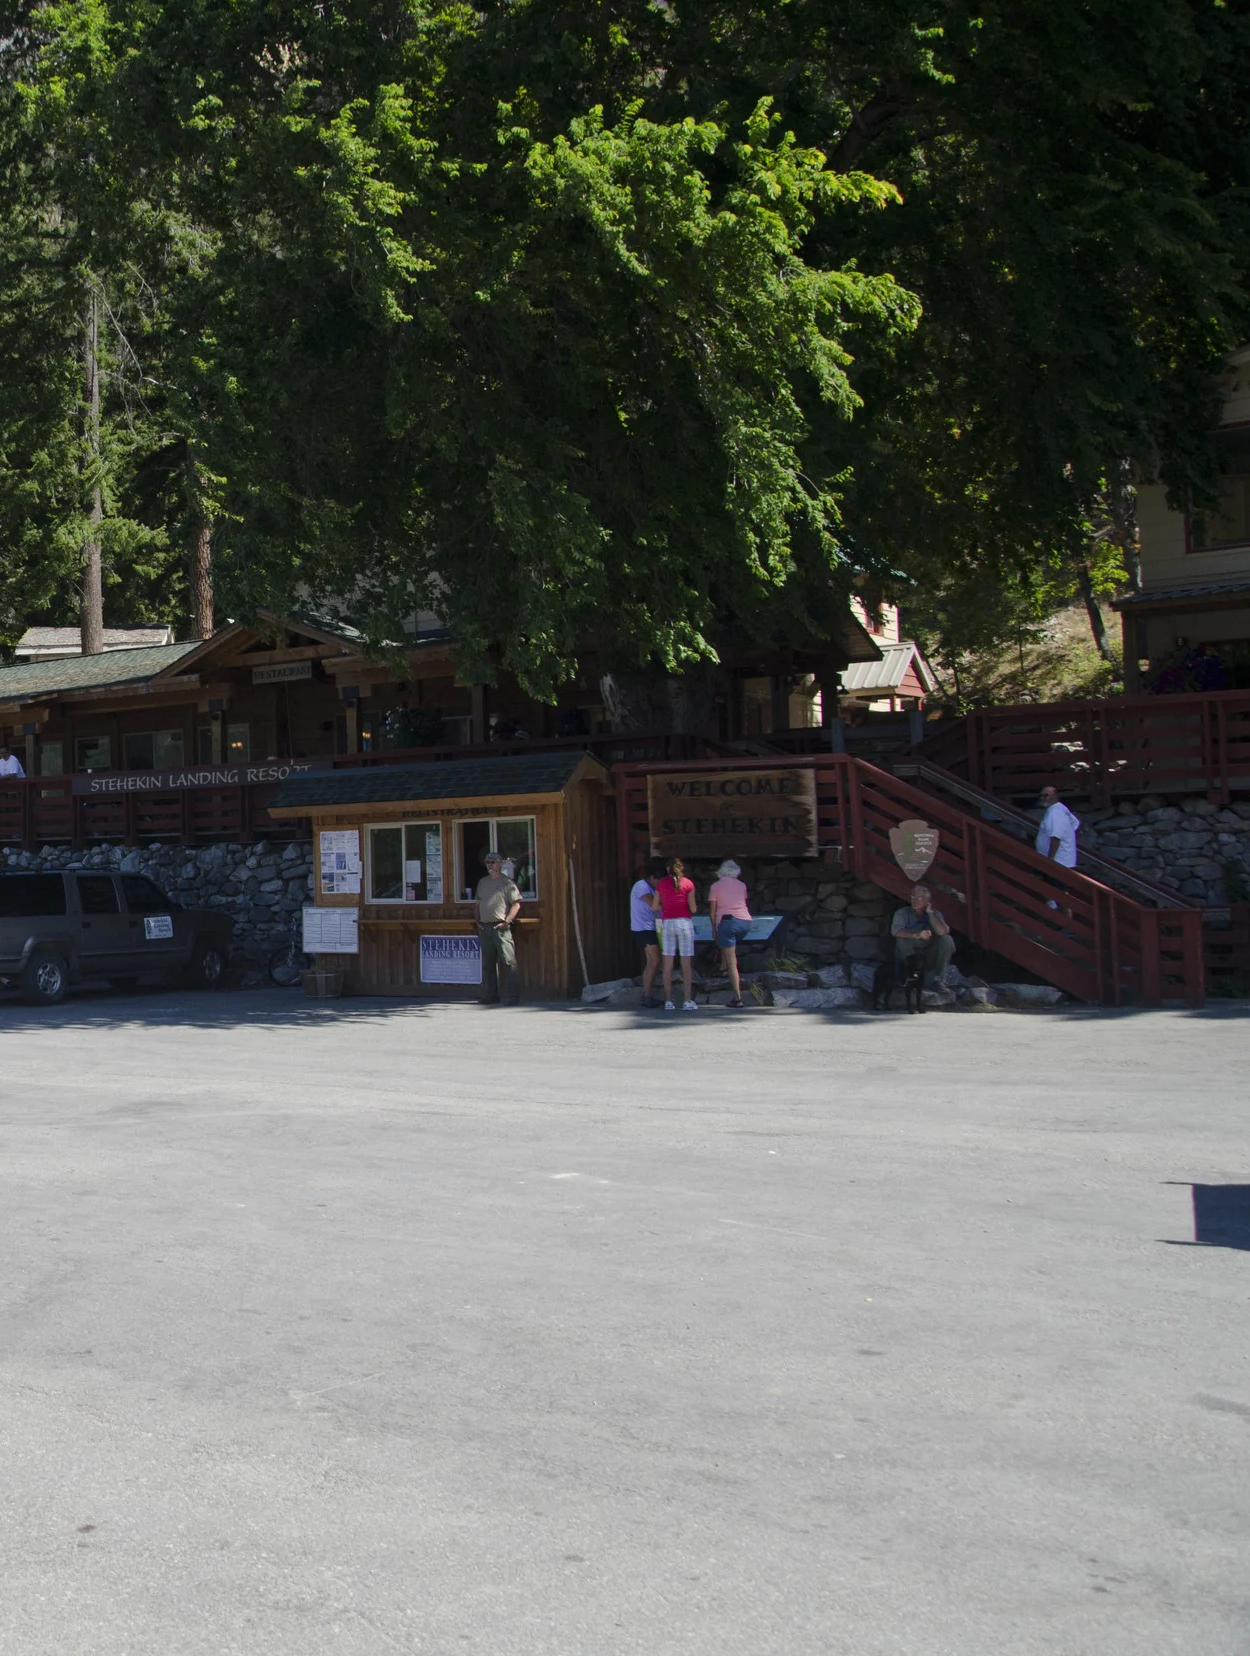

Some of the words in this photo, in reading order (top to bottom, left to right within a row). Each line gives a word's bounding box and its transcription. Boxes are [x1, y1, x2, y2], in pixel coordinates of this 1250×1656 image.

[90, 774, 162, 792] STEHEKIN
[169, 770, 239, 787] LANDING
[667, 777, 791, 797] WELCOME
[662, 816, 800, 835] STEHEKIN
[422, 939, 479, 951] STEHEKIN
[422, 950, 451, 958] LANDING
[452, 950, 479, 959] RESORT
